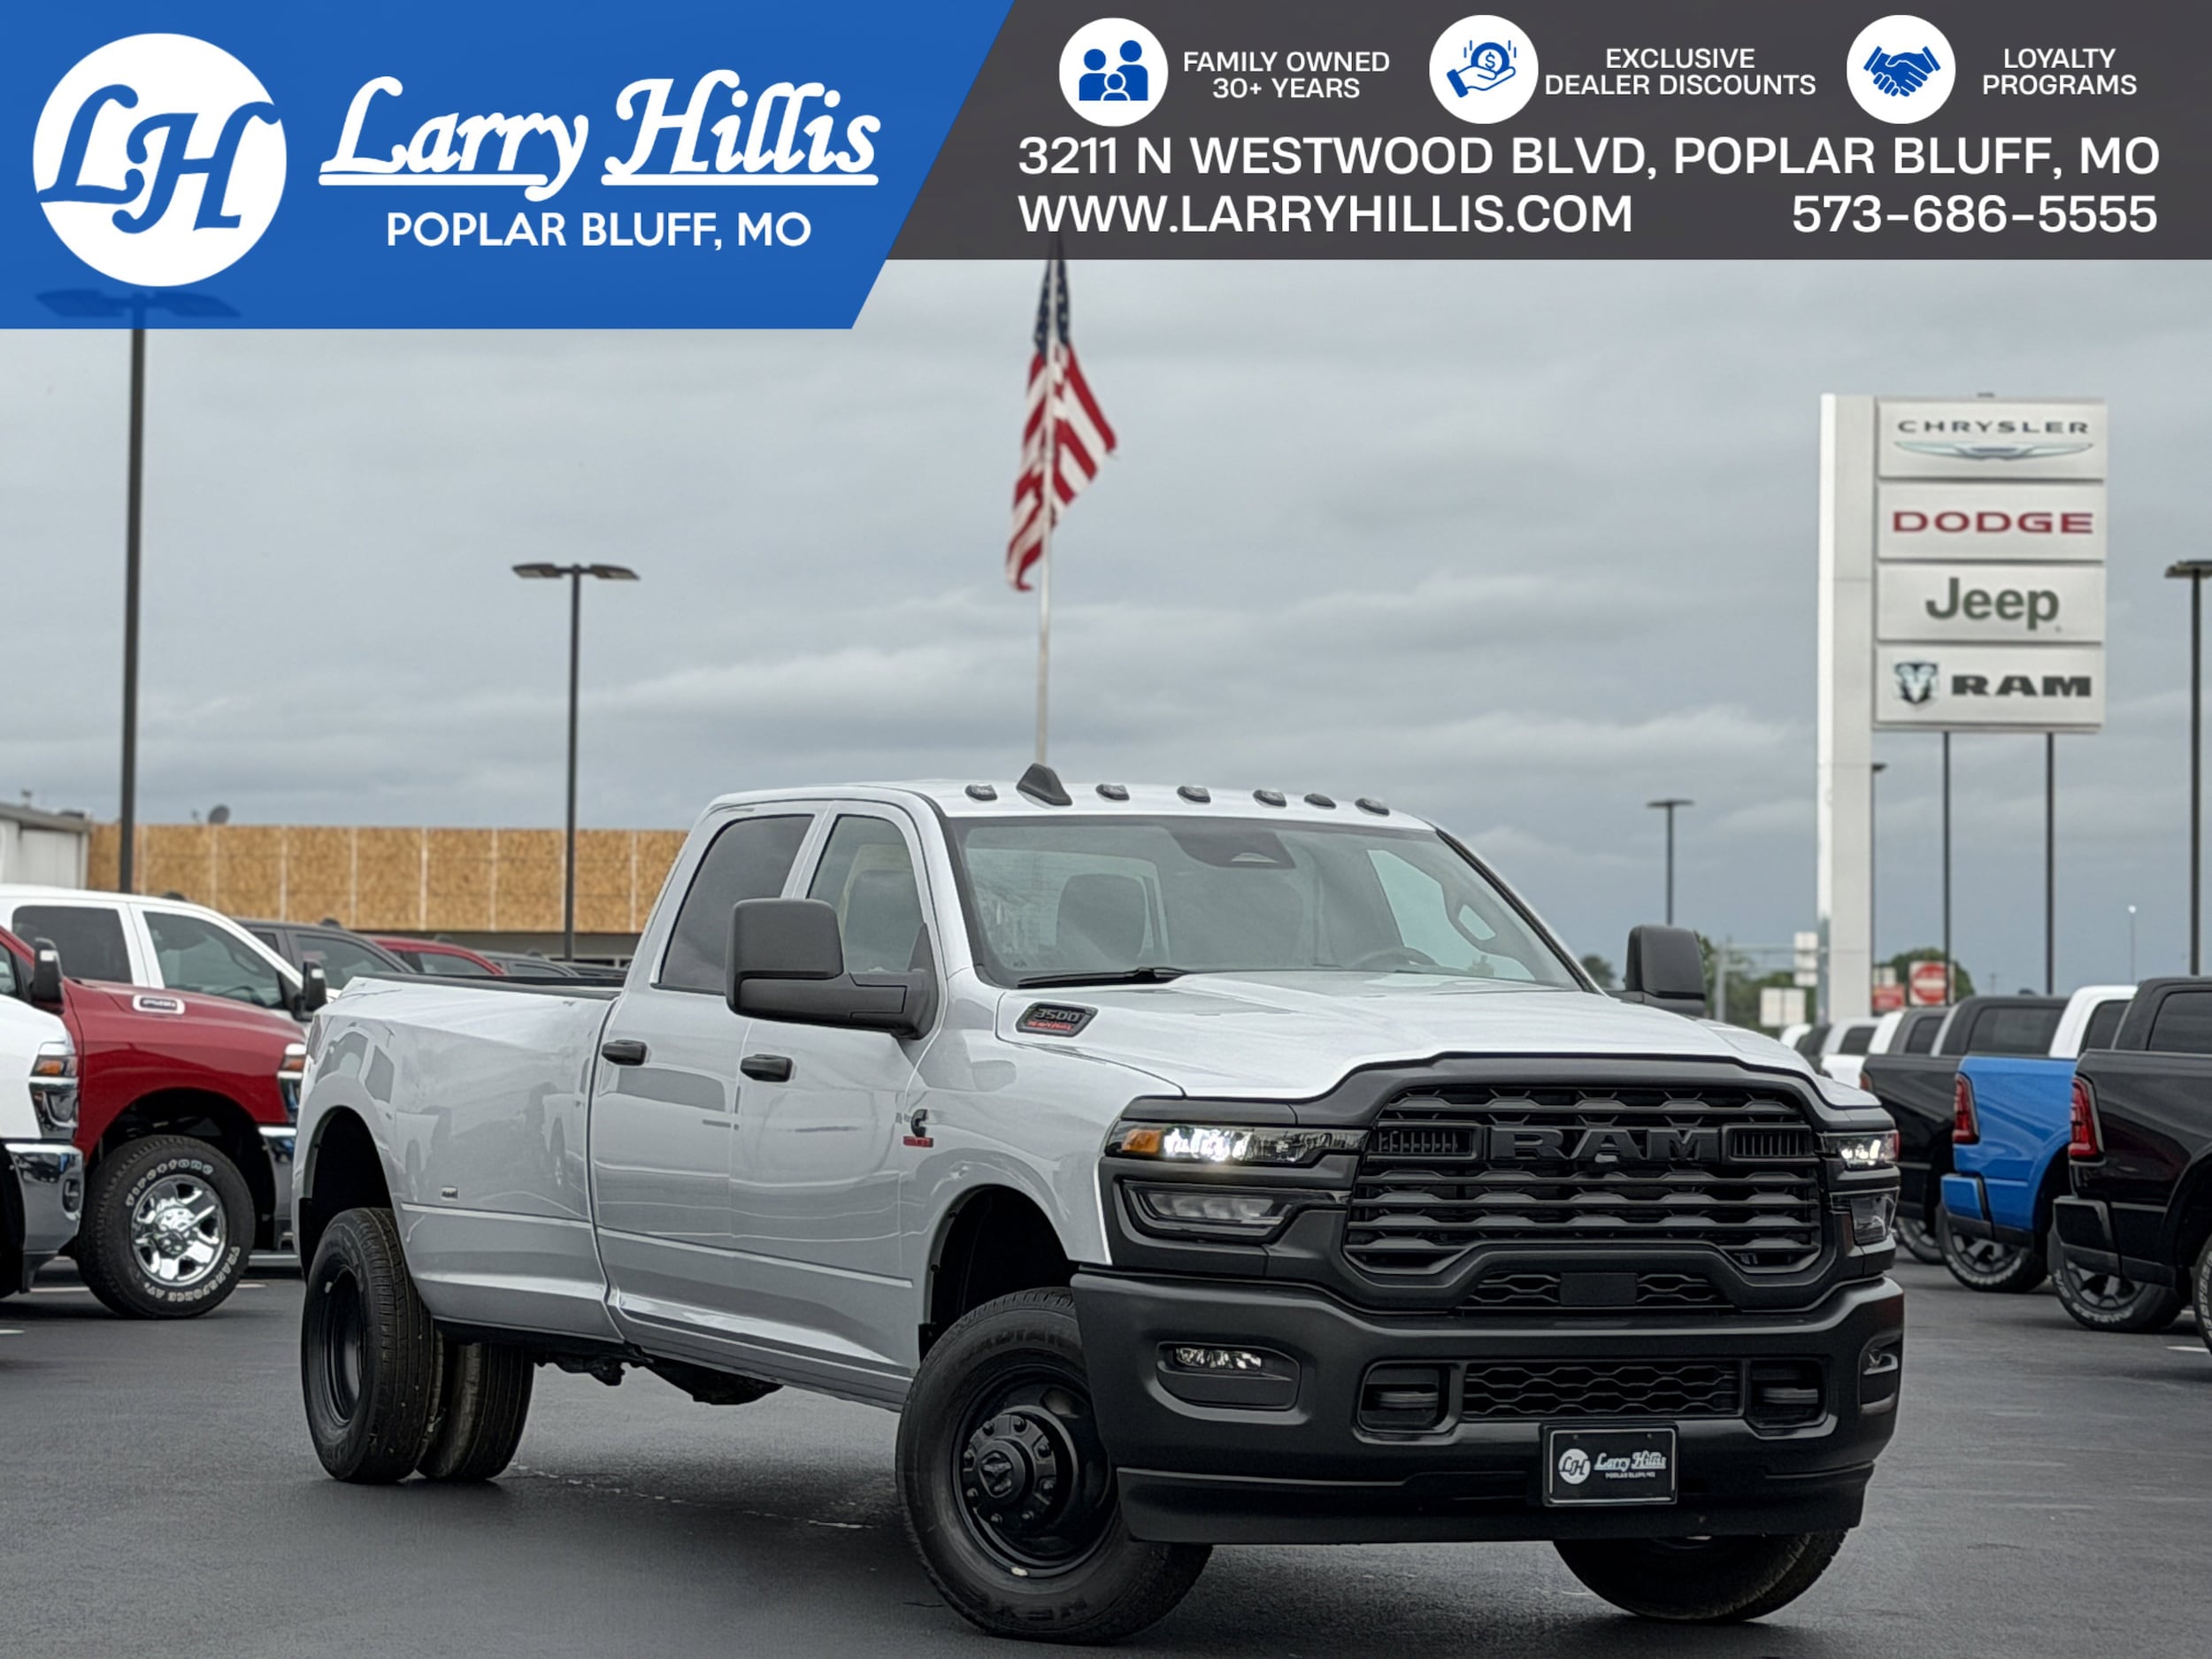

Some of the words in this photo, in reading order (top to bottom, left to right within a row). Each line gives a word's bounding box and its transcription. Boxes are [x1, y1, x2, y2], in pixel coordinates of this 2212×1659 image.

[1897, 420, 2090, 434] CHRYSLER
[1893, 511, 2094, 534] DODGE
[1925, 577, 2060, 631] Jeep
[1951, 675, 2092, 697] RAM
[1033, 1009, 1079, 1022] 3500
[1491, 1126, 1719, 1161] RAM
